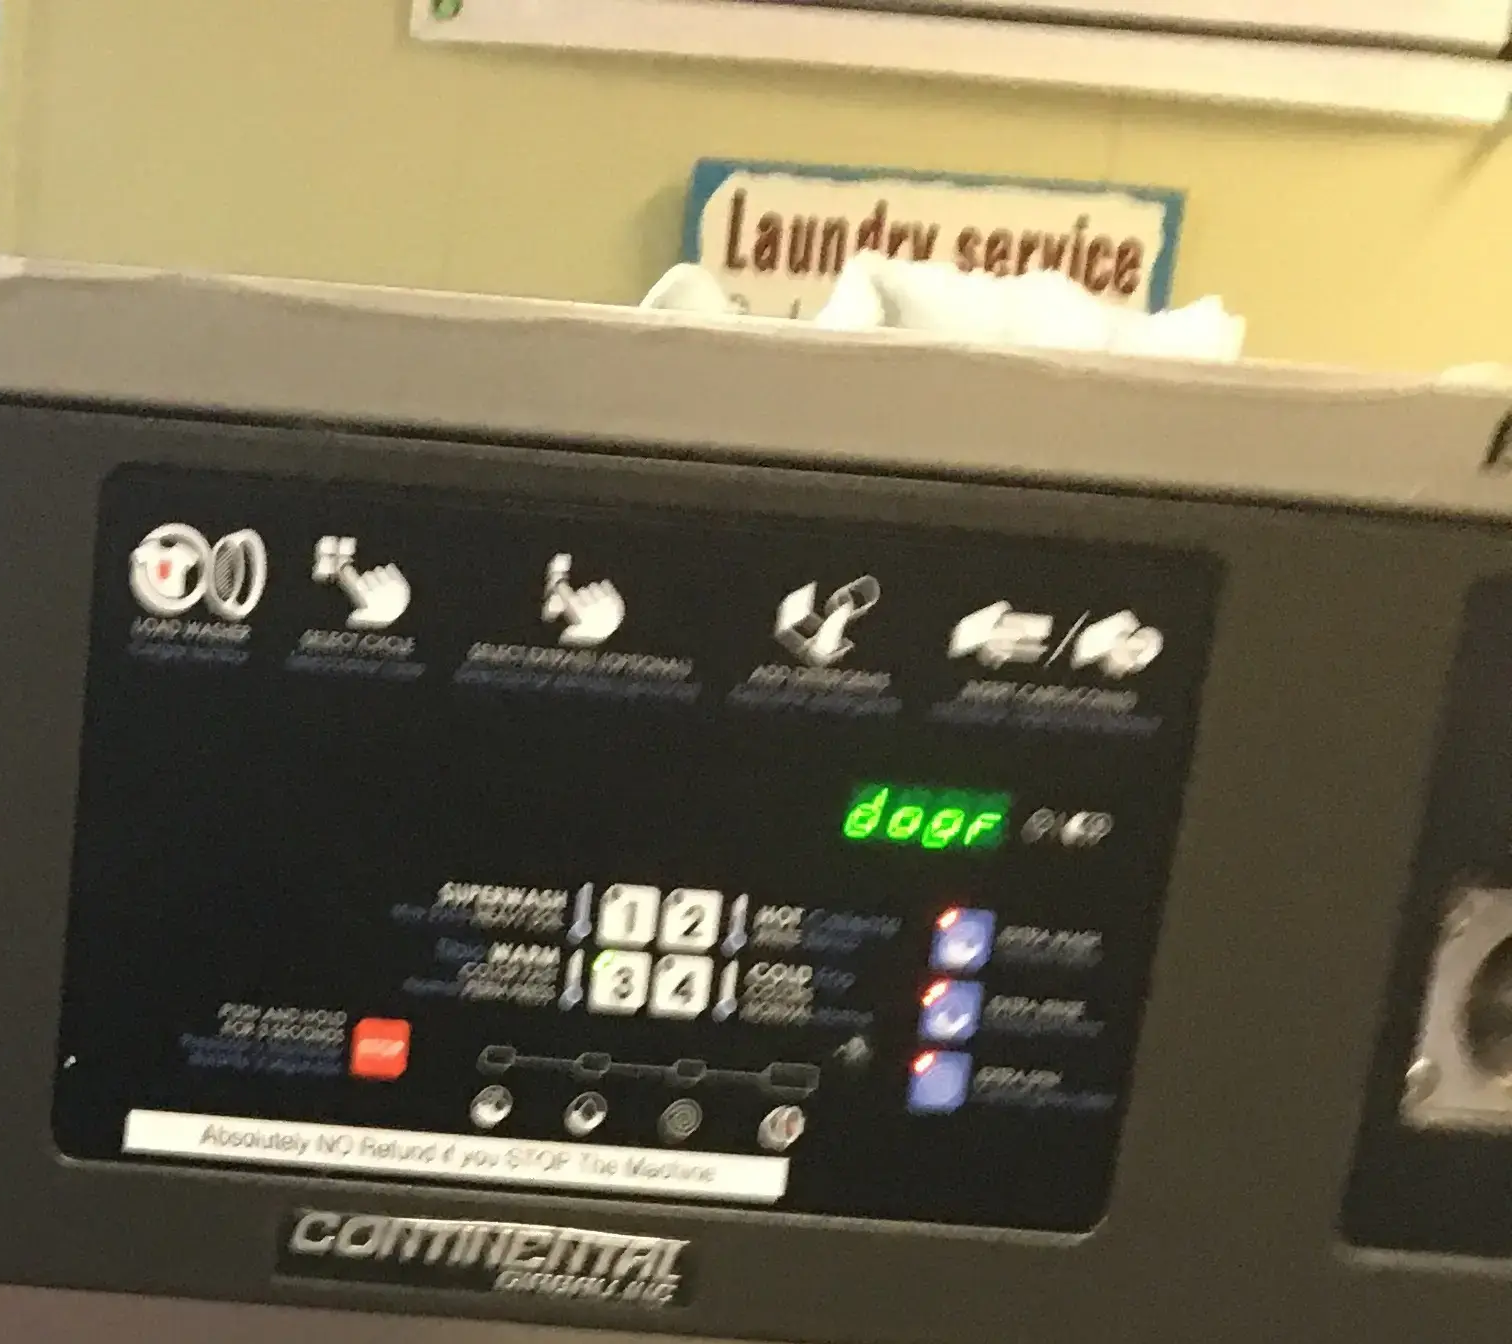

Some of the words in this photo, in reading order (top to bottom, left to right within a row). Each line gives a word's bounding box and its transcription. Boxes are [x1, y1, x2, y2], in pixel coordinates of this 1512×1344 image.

[727, 187, 939, 276] Laundry
[956, 213, 1145, 296] service
[680, 904, 707, 937] 2
[612, 965, 635, 1000] 3
[670, 970, 697, 1005] 4
[199, 1123, 311, 1156] Absolutely
[317, 1133, 355, 1157] NO
[359, 1136, 438, 1163] Refund
[460, 1149, 499, 1169] you
[505, 1146, 570, 1172] STOP
[579, 1152, 619, 1178] The
[624, 1155, 718, 1184] Machine
